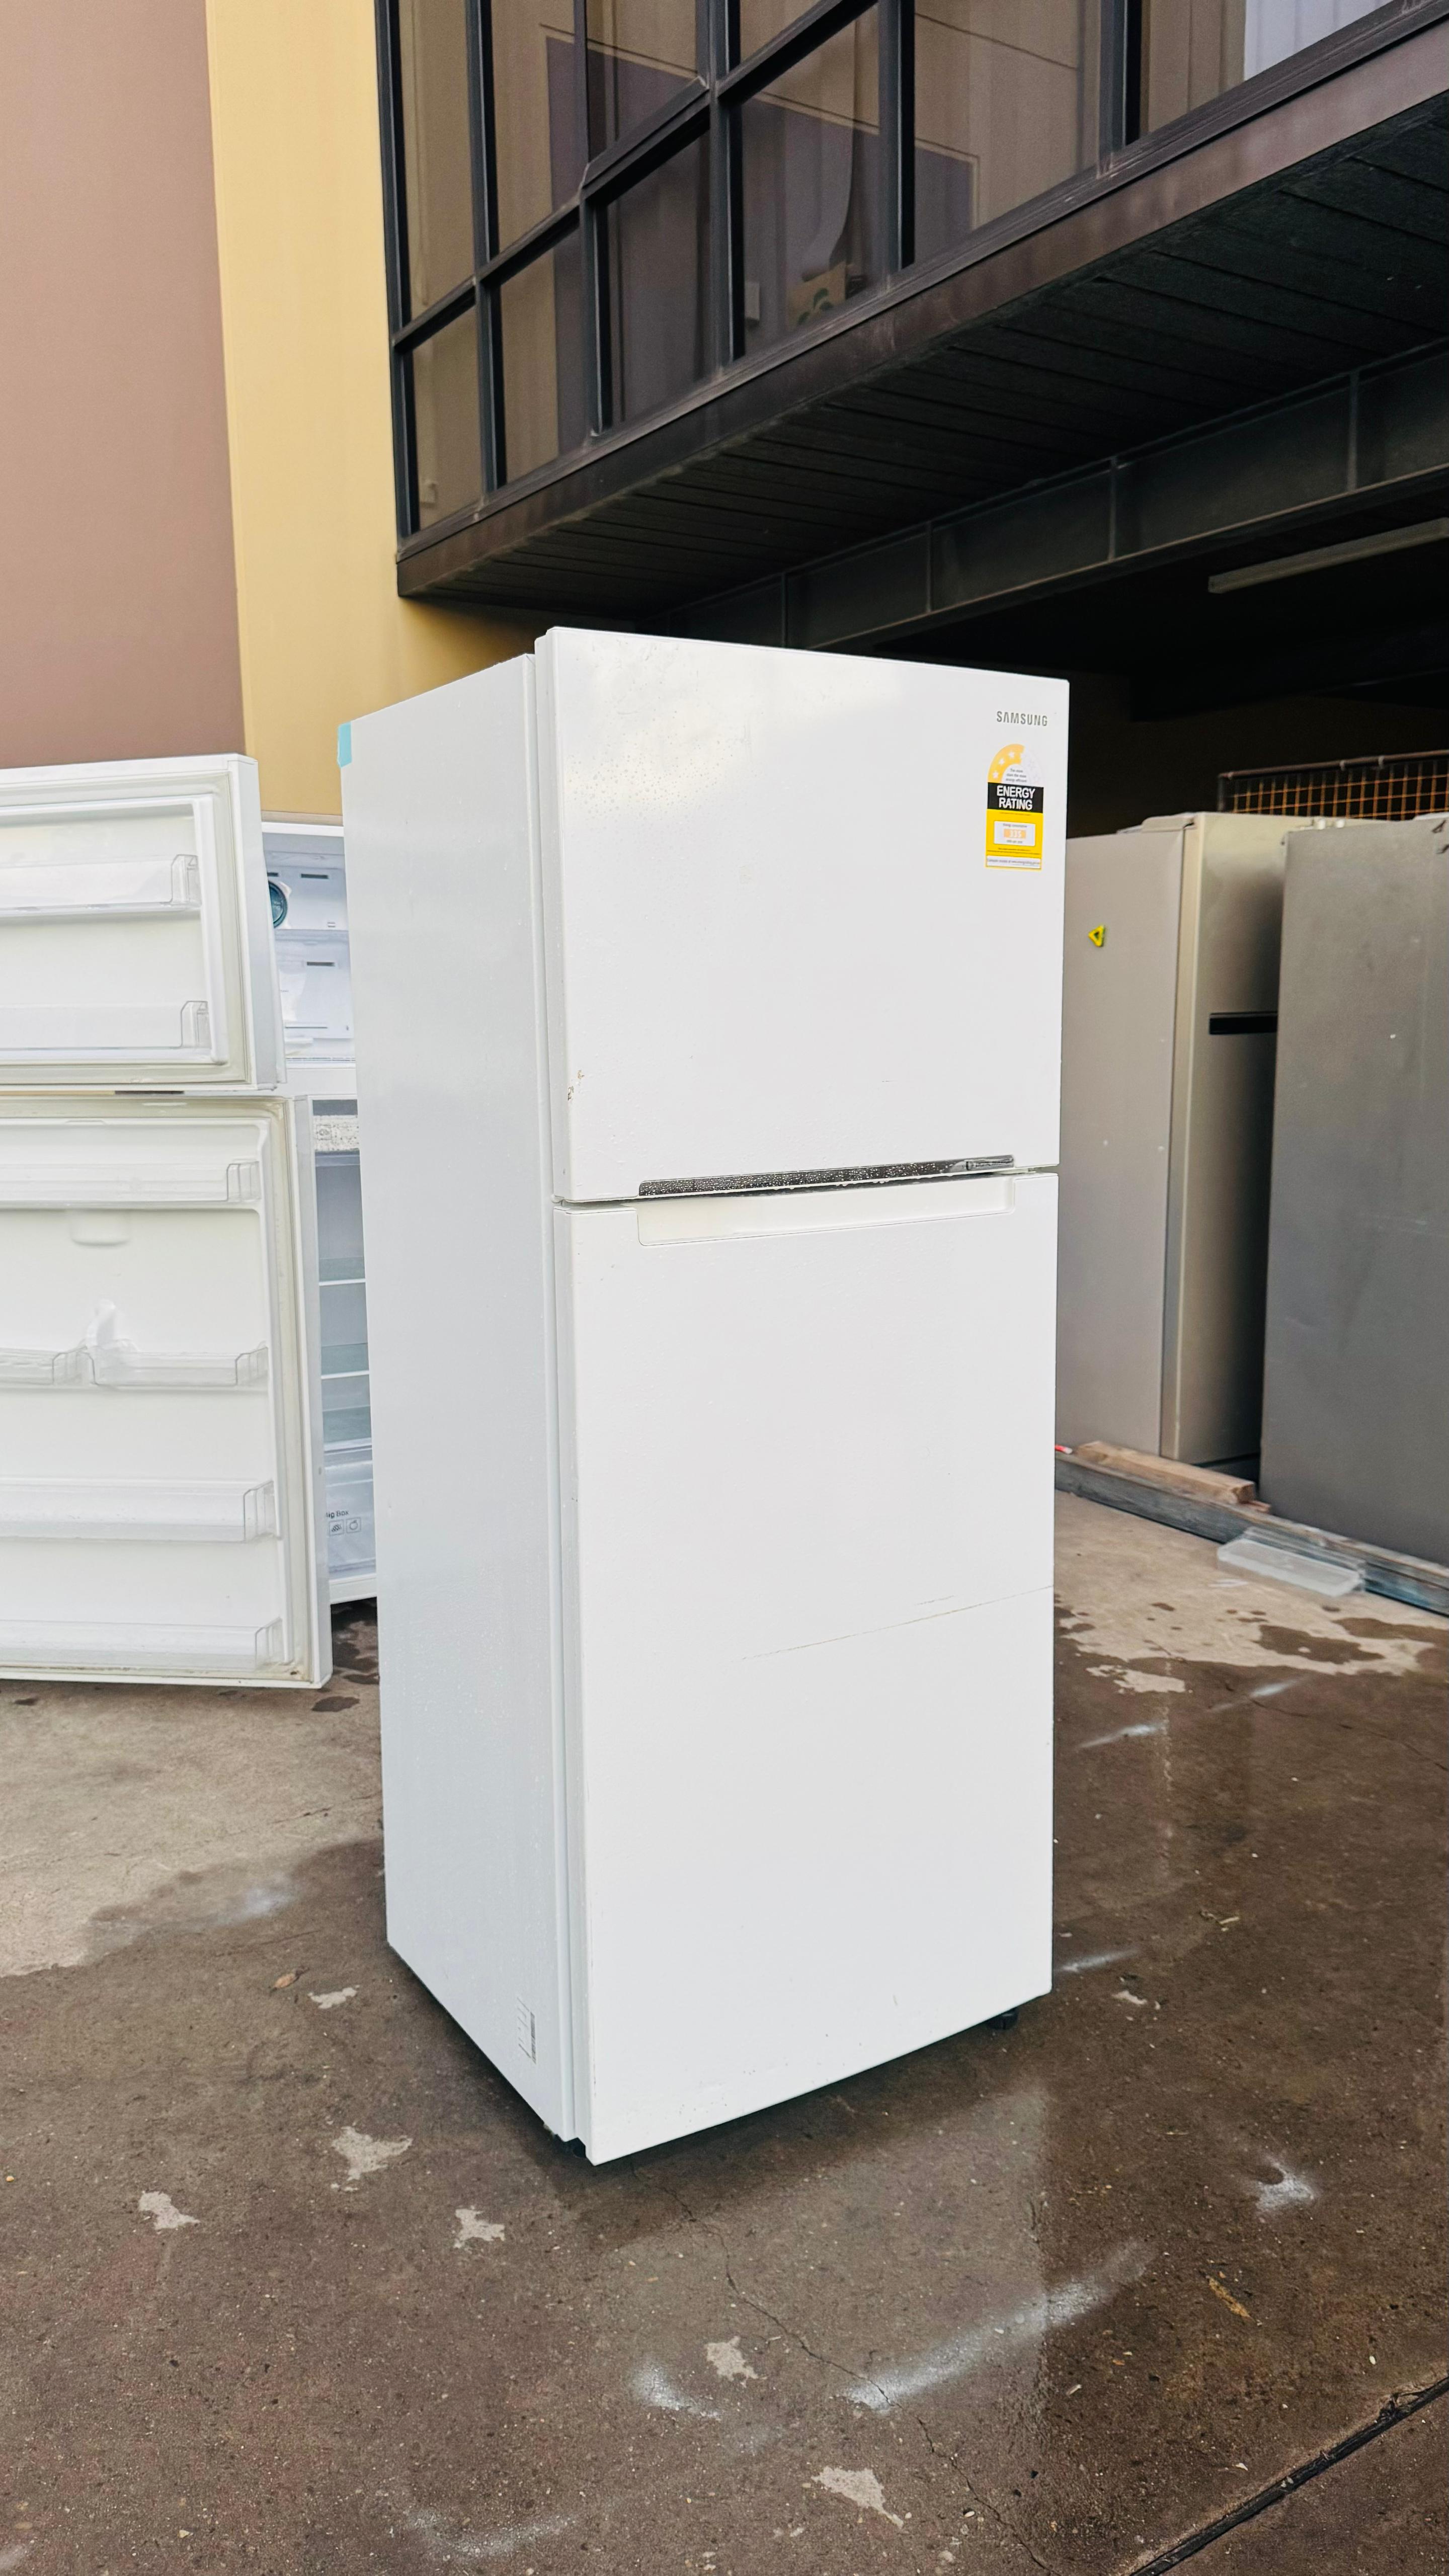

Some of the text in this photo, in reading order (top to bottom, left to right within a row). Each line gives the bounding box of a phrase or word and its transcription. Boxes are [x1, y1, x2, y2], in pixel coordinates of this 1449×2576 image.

[996, 711, 1047, 726] SAMSUNG
[997, 785, 1035, 798] ENERGY
[999, 797, 1032, 811] RATING
